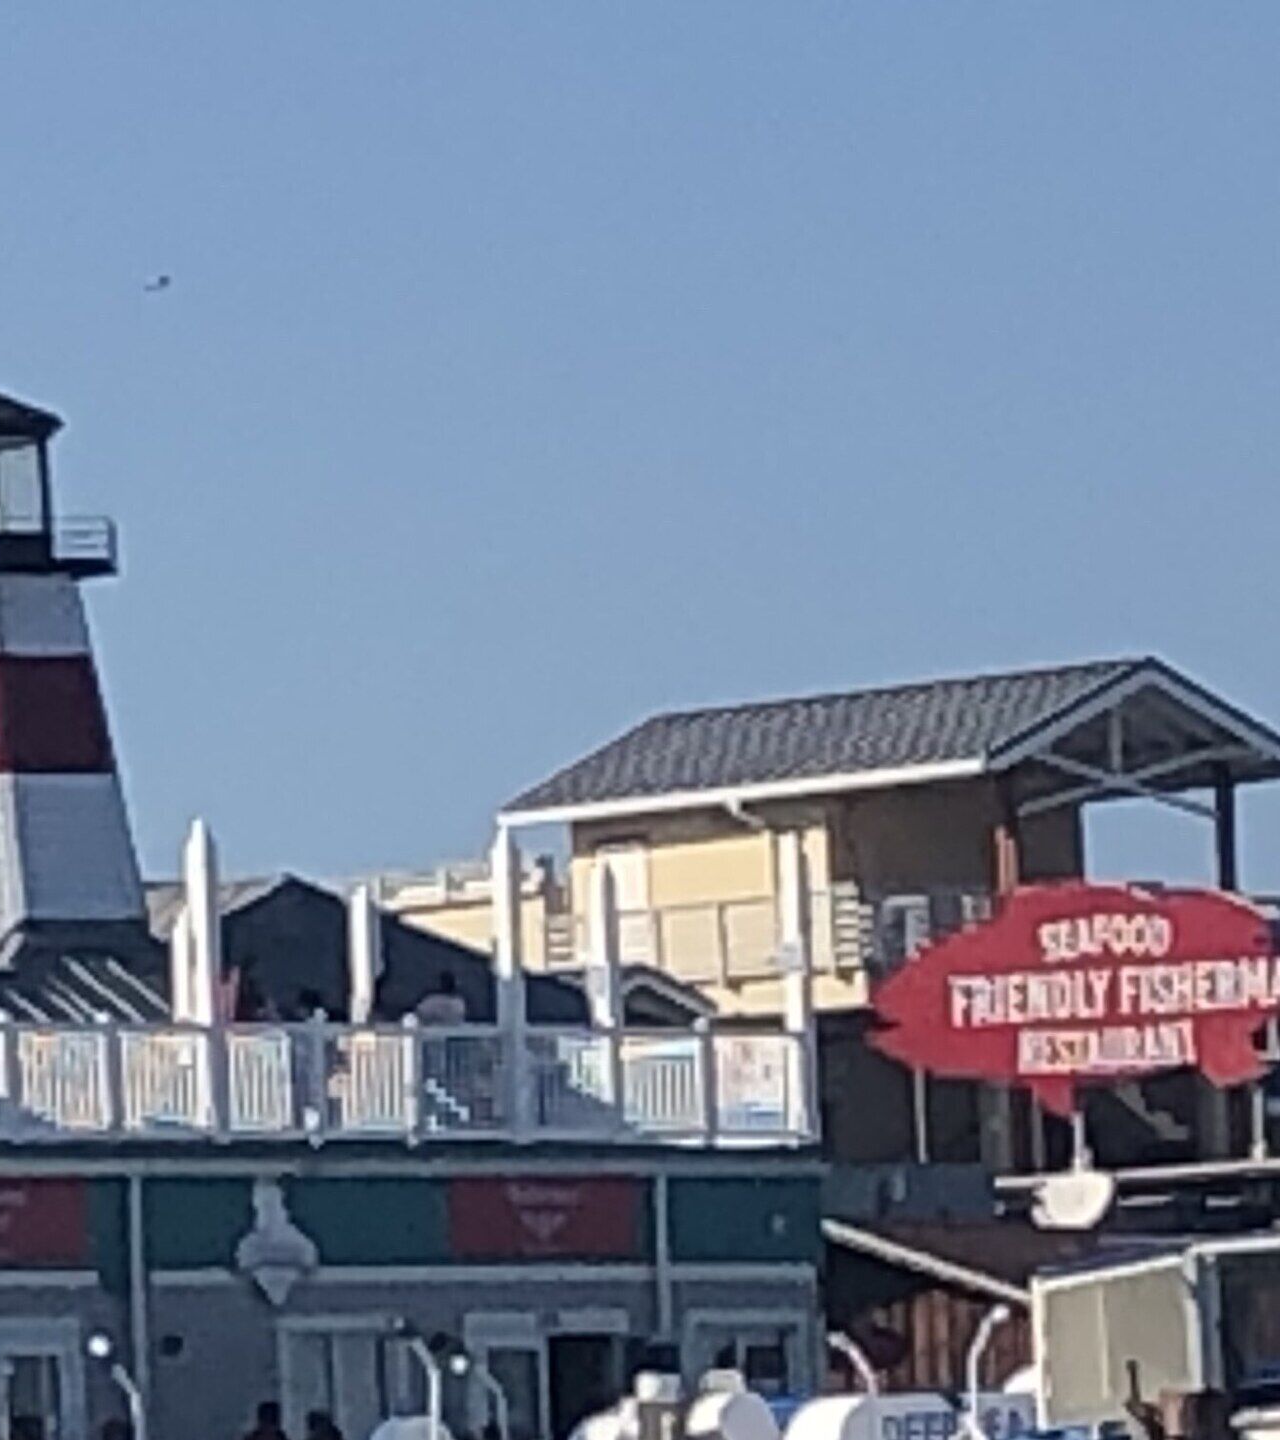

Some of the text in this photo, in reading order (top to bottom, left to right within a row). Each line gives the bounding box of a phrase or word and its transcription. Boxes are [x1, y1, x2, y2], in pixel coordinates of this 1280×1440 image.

[1039, 914, 1171, 961] SEAFOOD
[949, 968, 1112, 1027] FRIENDLY
[1020, 1021, 1196, 1072] RESTAURANT
